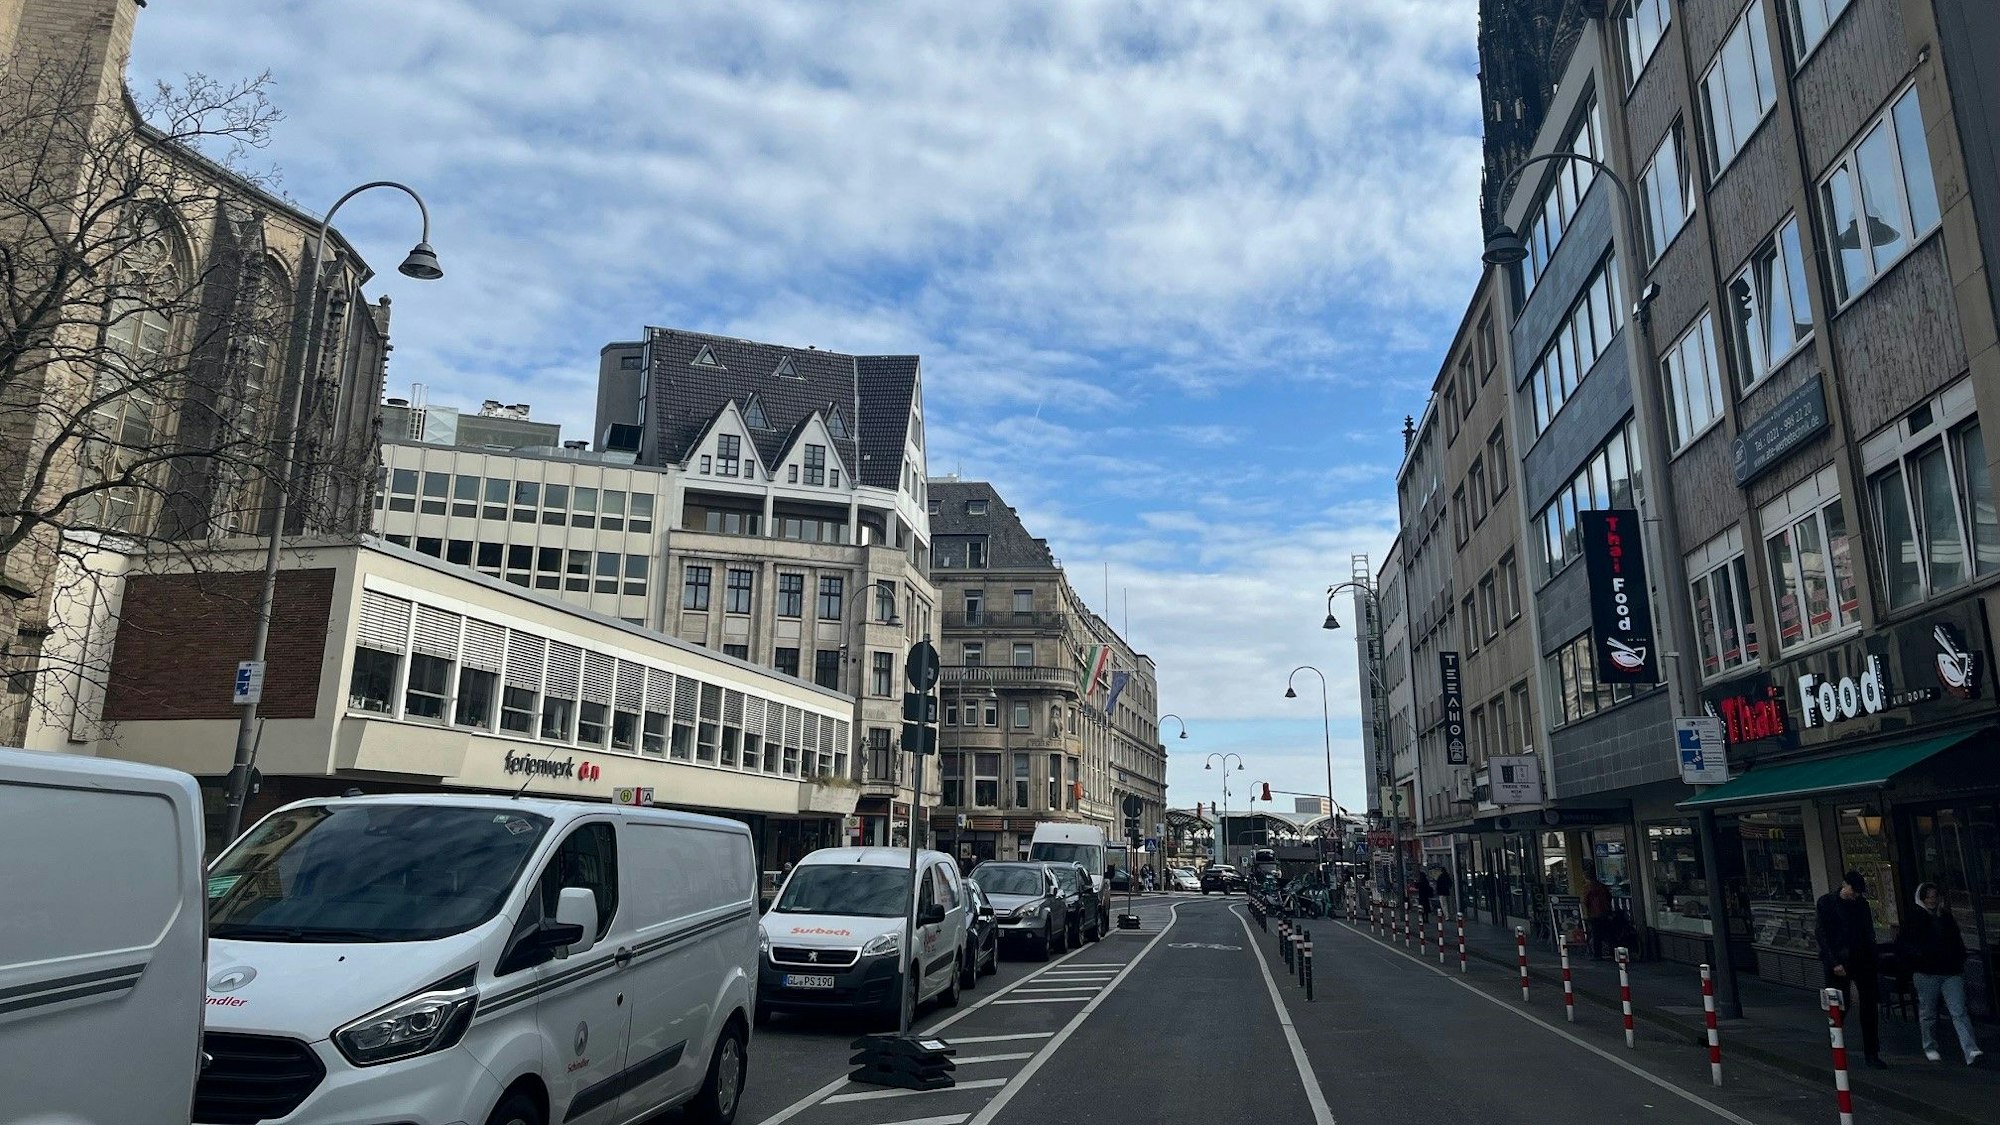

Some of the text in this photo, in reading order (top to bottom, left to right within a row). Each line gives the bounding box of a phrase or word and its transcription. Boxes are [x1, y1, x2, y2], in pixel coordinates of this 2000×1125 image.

[1605, 515, 1631, 631] Thai Food
[1720, 686, 1784, 744] Thai
[1798, 653, 1884, 728] Food
[504, 749, 575, 779] ferienwerk
[644, 792, 652, 802] A
[790, 927, 851, 937] Surbach
[787, 976, 799, 986] GL
[816, 976, 833, 987] 190
[205, 995, 248, 1007] indler
